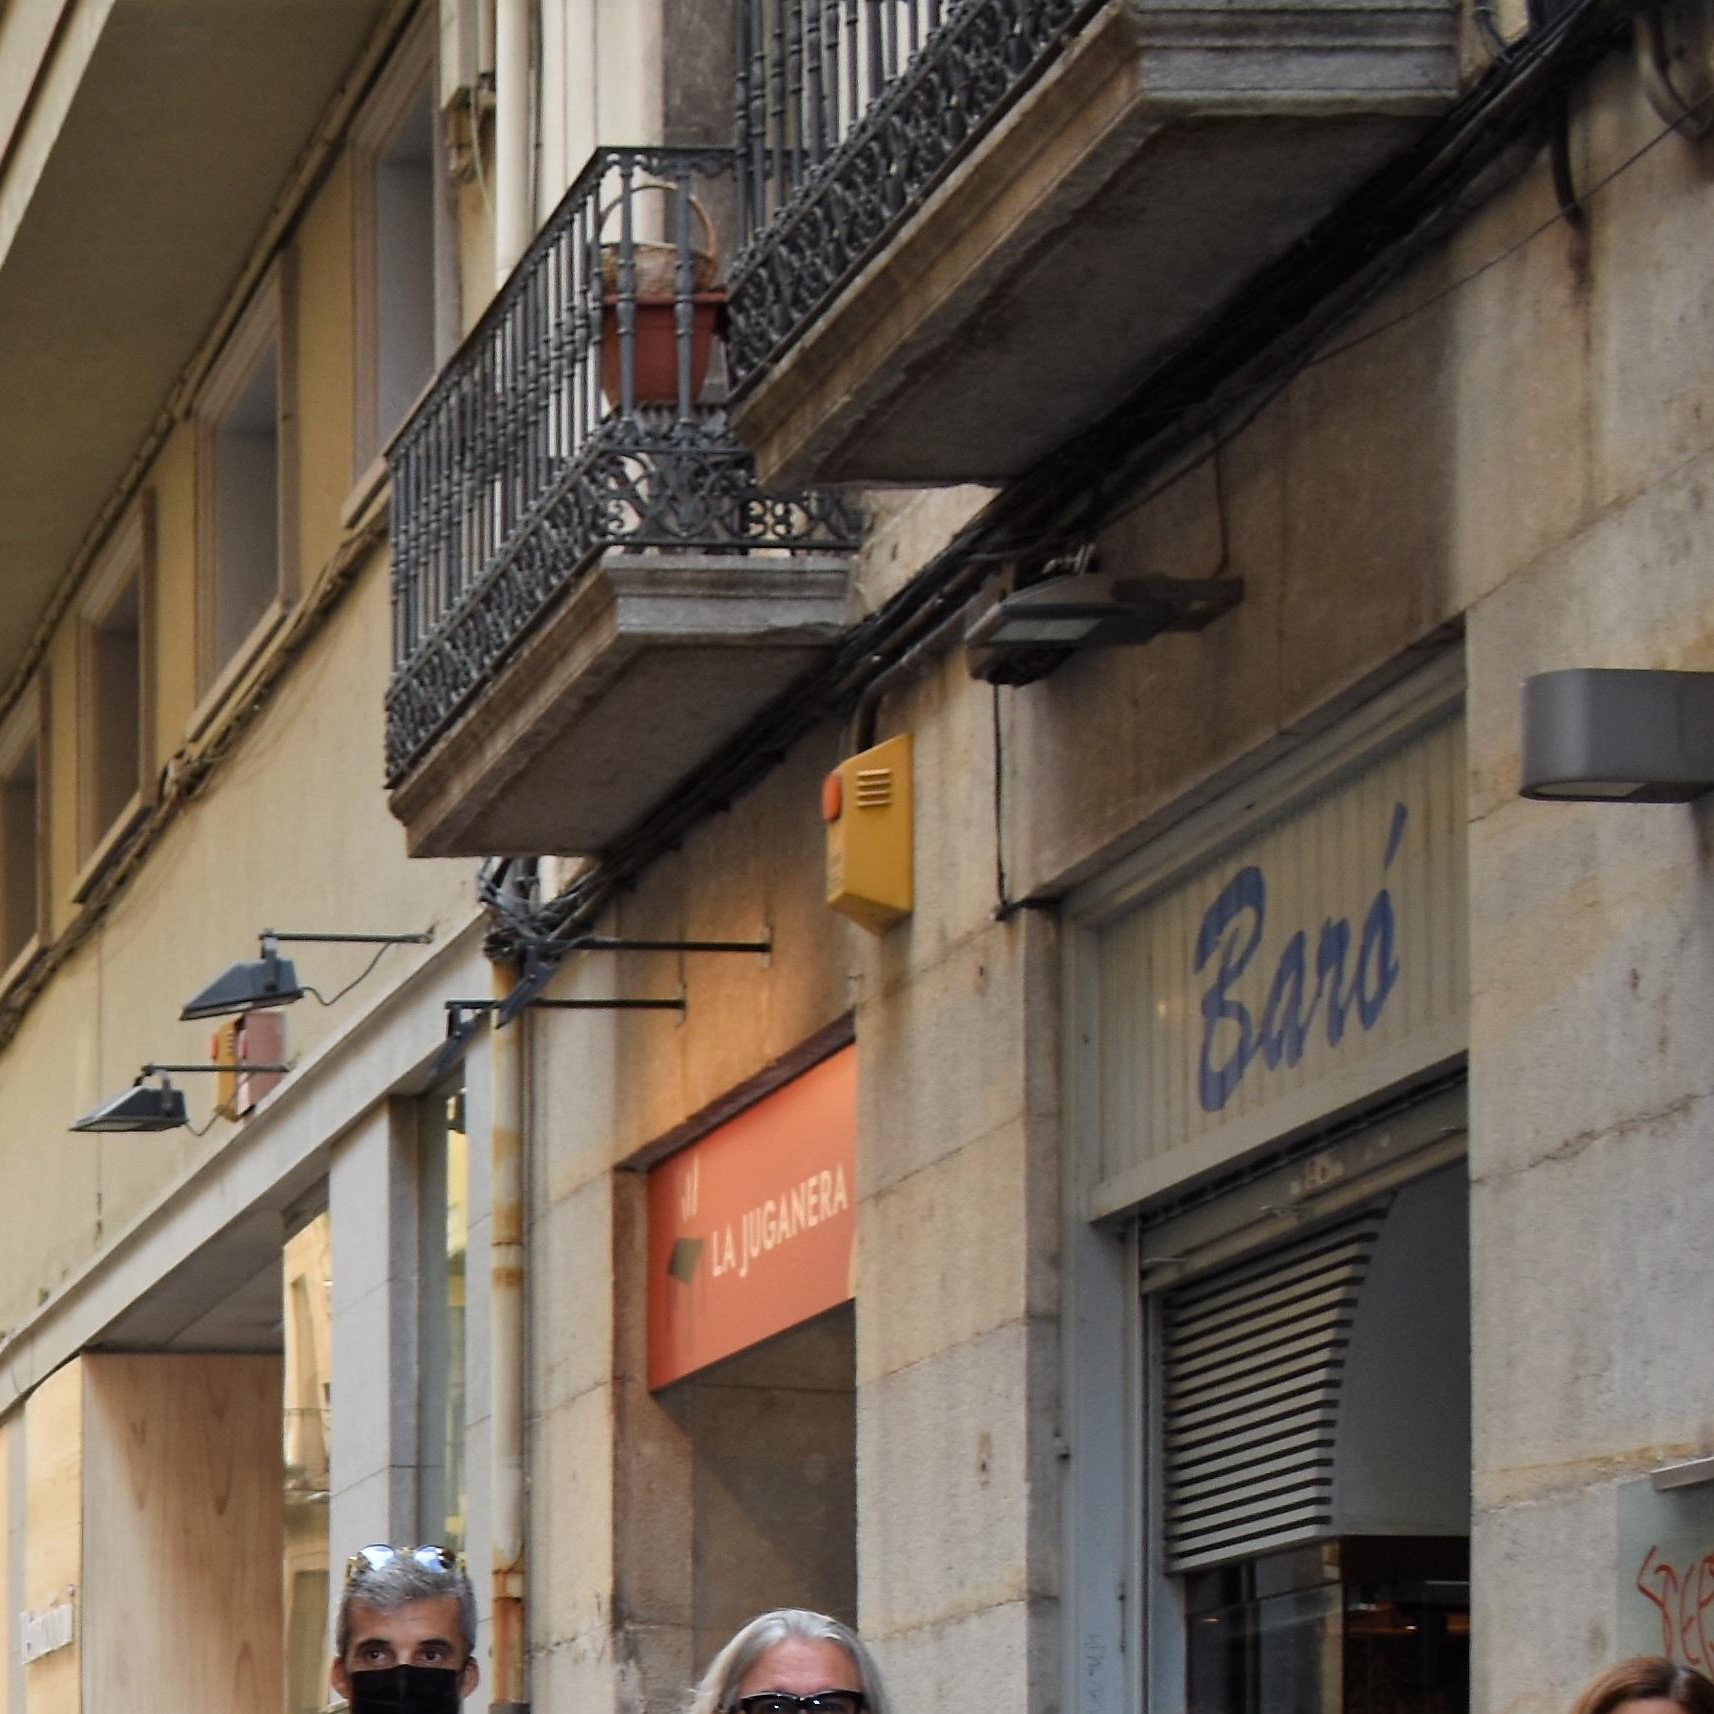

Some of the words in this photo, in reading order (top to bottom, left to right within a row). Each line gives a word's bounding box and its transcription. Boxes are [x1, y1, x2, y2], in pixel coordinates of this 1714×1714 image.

[1193, 802, 1407, 1112] Baró
[713, 1224, 736, 1276] LA
[739, 1162, 848, 1278] JUGANERA
